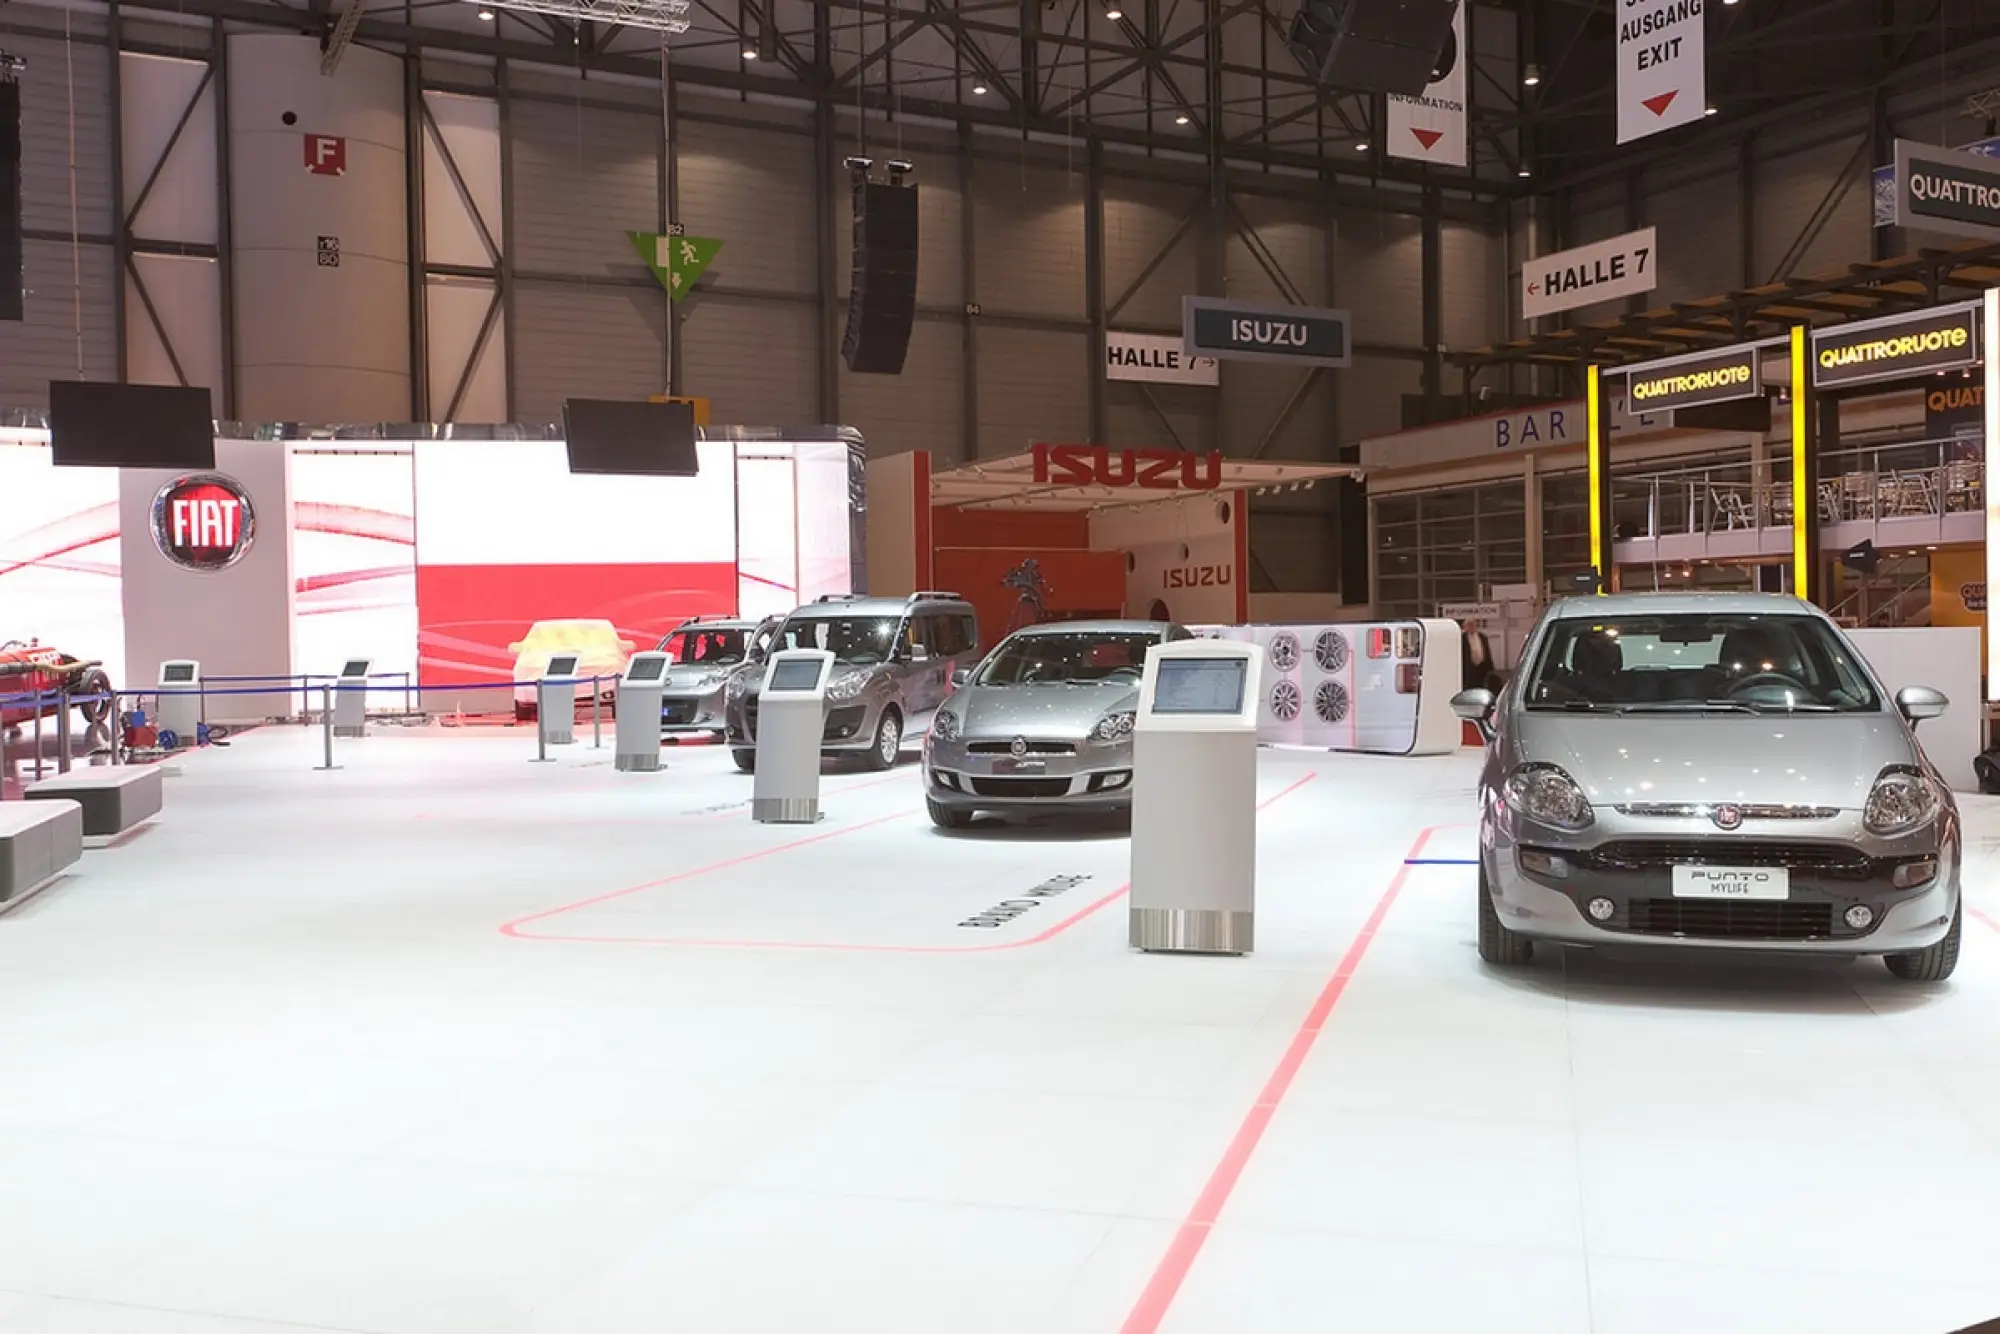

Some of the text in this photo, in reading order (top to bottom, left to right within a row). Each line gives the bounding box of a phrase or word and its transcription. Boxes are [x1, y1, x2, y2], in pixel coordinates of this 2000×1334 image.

[1620, 0, 1701, 44] AUSGANG
[1637, 36, 1682, 71] EXIT
[316, 138, 337, 165] F
[1909, 172, 2000, 210] QUATTRO
[1544, 247, 1649, 297] HALLE 7
[1231, 319, 1308, 347] ISUZU
[1107, 346, 1180, 370] HALLE
[1495, 410, 1566, 448] BAR
[1031, 442, 1223, 491] ISUZU
[173, 499, 239, 548] FIAT
[1163, 564, 1232, 589] ISUZU
[1710, 883, 1749, 895] MYLIFE
